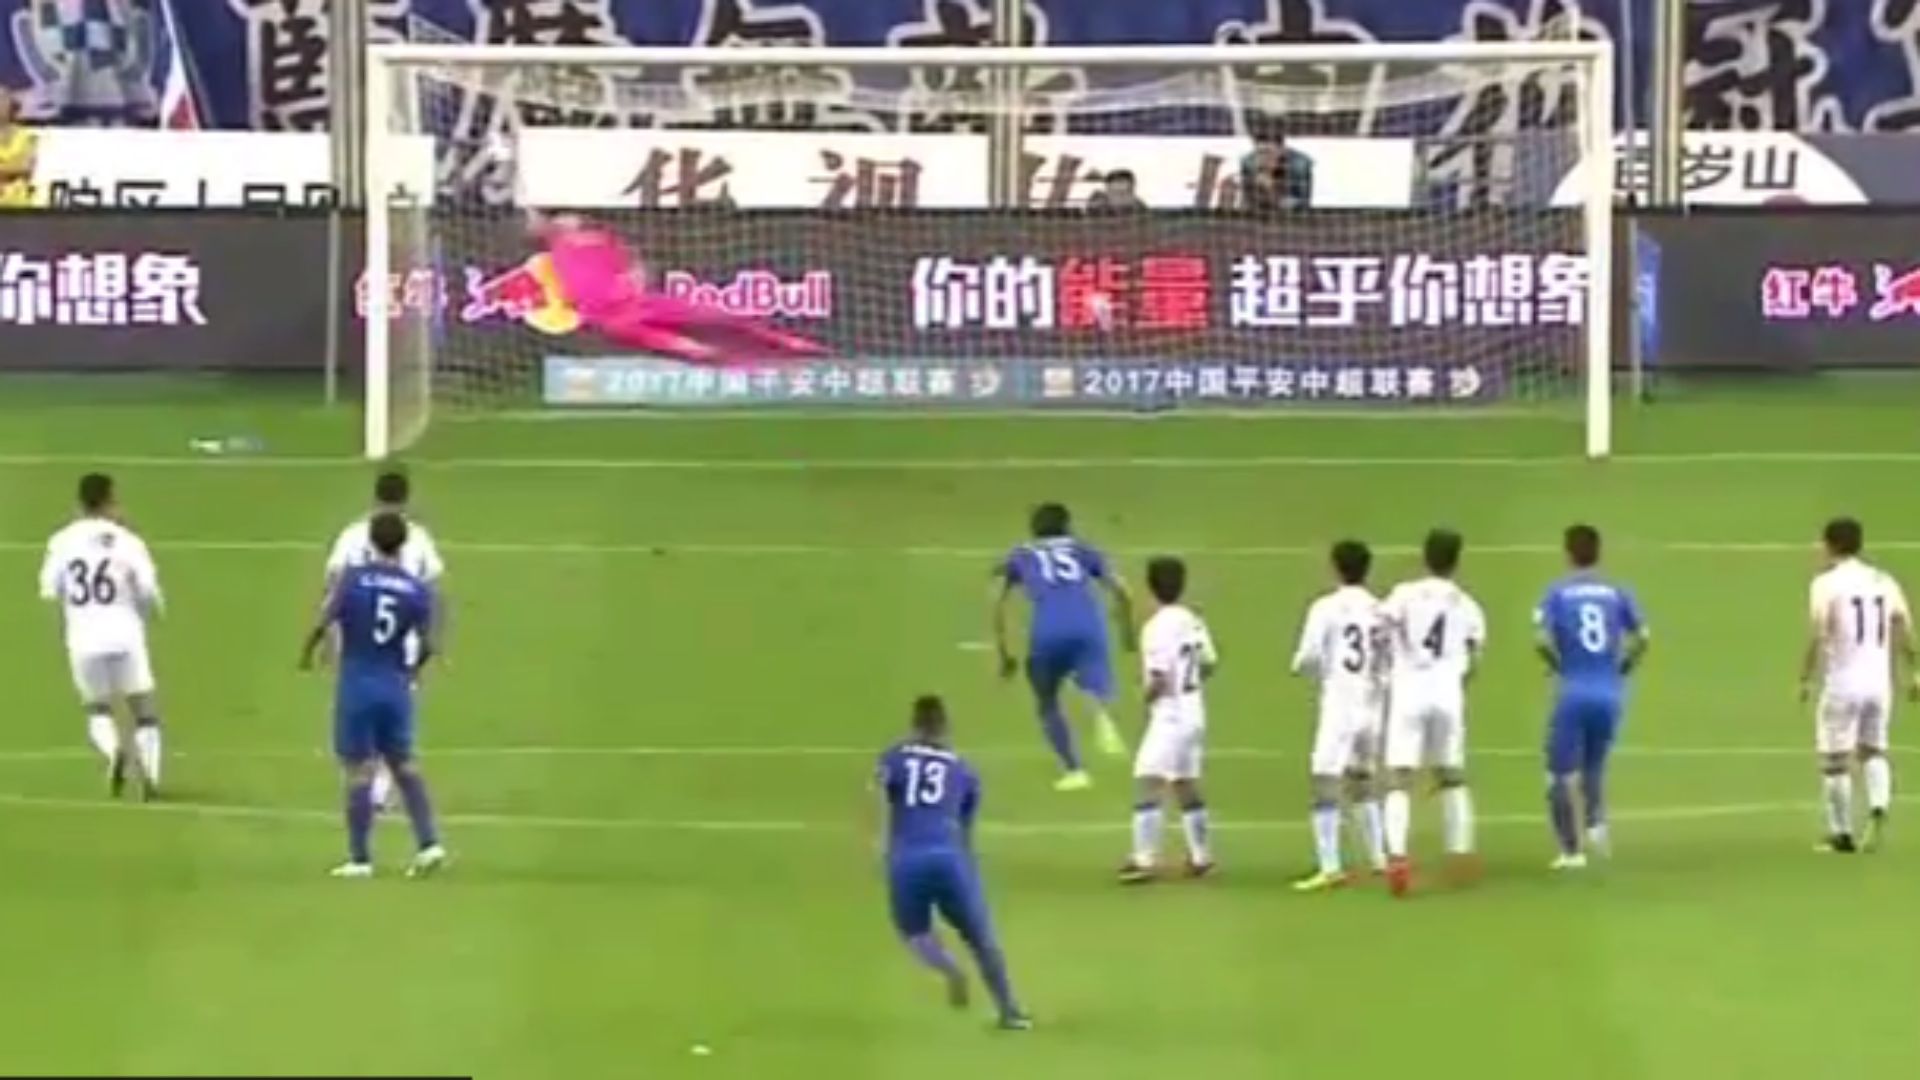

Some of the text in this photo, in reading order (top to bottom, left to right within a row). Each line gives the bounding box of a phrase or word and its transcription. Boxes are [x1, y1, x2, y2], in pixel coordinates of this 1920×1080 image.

[912, 257, 1208, 329] 你的能量
[1761, 267, 1858, 319] 红牛
[66, 559, 117, 606] 36
[1034, 546, 1082, 582] 15
[373, 595, 397, 644] 5
[1422, 611, 1447, 660] 4
[1578, 604, 1605, 653] 8
[1851, 596, 1886, 648] 11
[904, 758, 946, 806] 13
